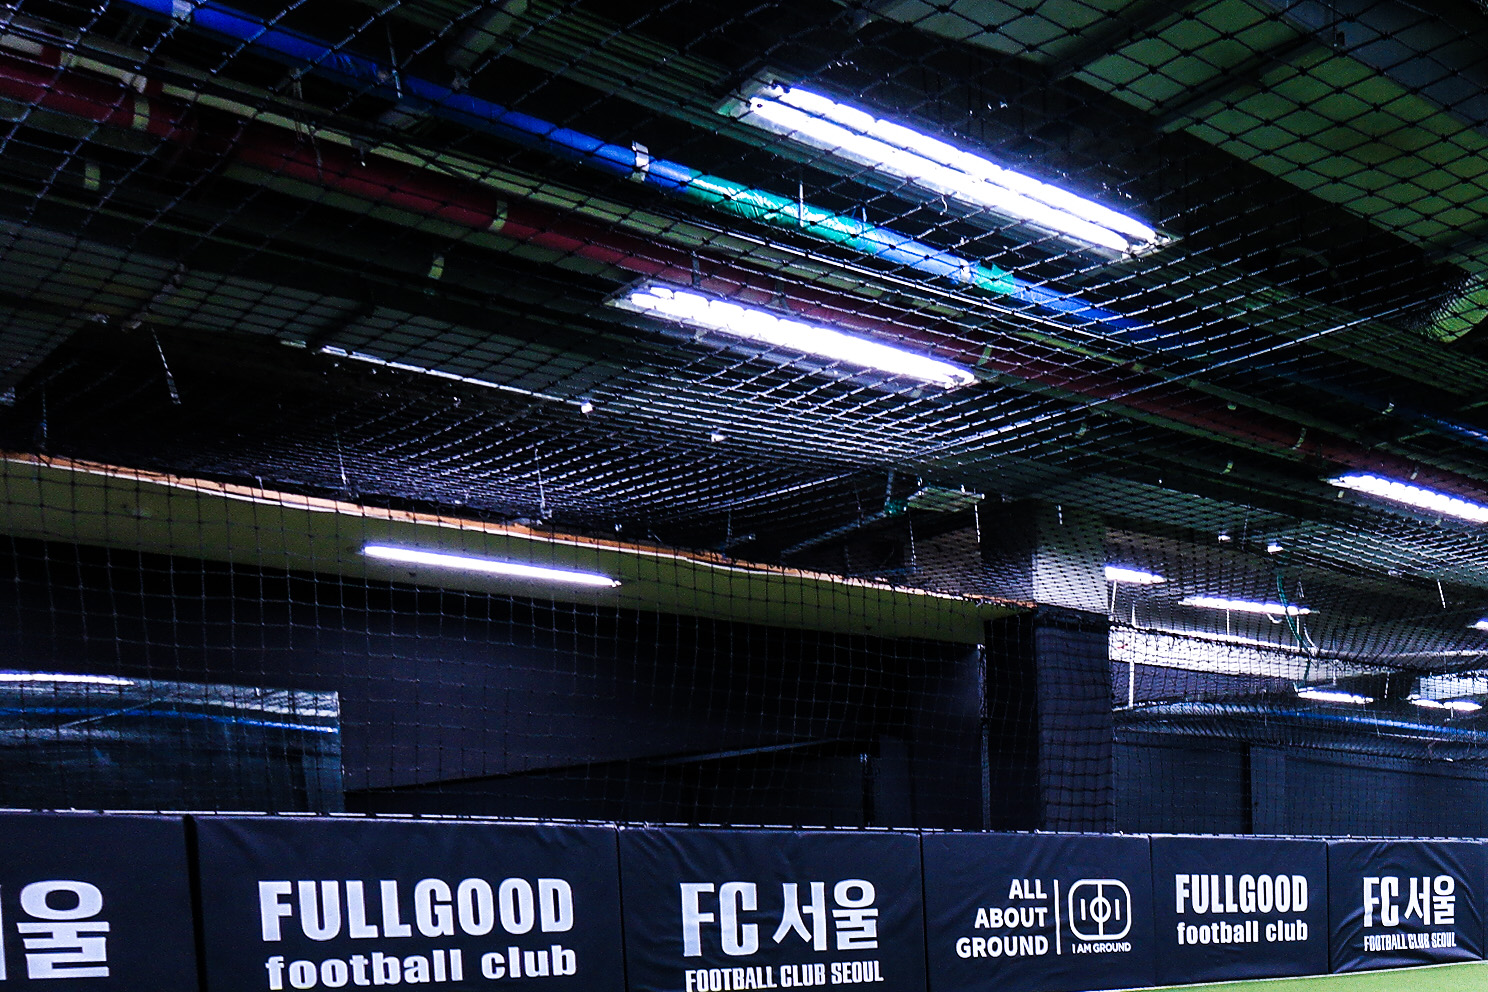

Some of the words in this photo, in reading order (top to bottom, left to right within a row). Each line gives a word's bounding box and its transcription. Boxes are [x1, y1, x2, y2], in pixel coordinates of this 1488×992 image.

[1008, 878, 1048, 900] ALL
[1175, 873, 1308, 915] FULLGOOD
[1362, 875, 1399, 928] FC
[1404, 874, 1456, 926] 서울
[258, 877, 574, 941] FULLGOOD
[679, 881, 759, 957] FC
[772, 878, 879, 952] 서울
[974, 906, 1048, 929] ABOUT
[0, 880, 110, 981] 울
[1176, 920, 1259, 945] football
[1265, 919, 1308, 943] club
[1364, 933, 1408, 952] FOOTBALL
[1407, 932, 1430, 950] CLUB
[1431, 931, 1457, 949] SEOUL
[955, 935, 1049, 959] GROUND
[1072, 943, 1076, 954] I
[1077, 943, 1092, 954] AM
[1092, 942, 1132, 954] GROUND
[264, 948, 463, 991] football
[481, 944, 577, 980] club
[780, 963, 826, 988] CLUB
[830, 960, 884, 985] SEOUL
